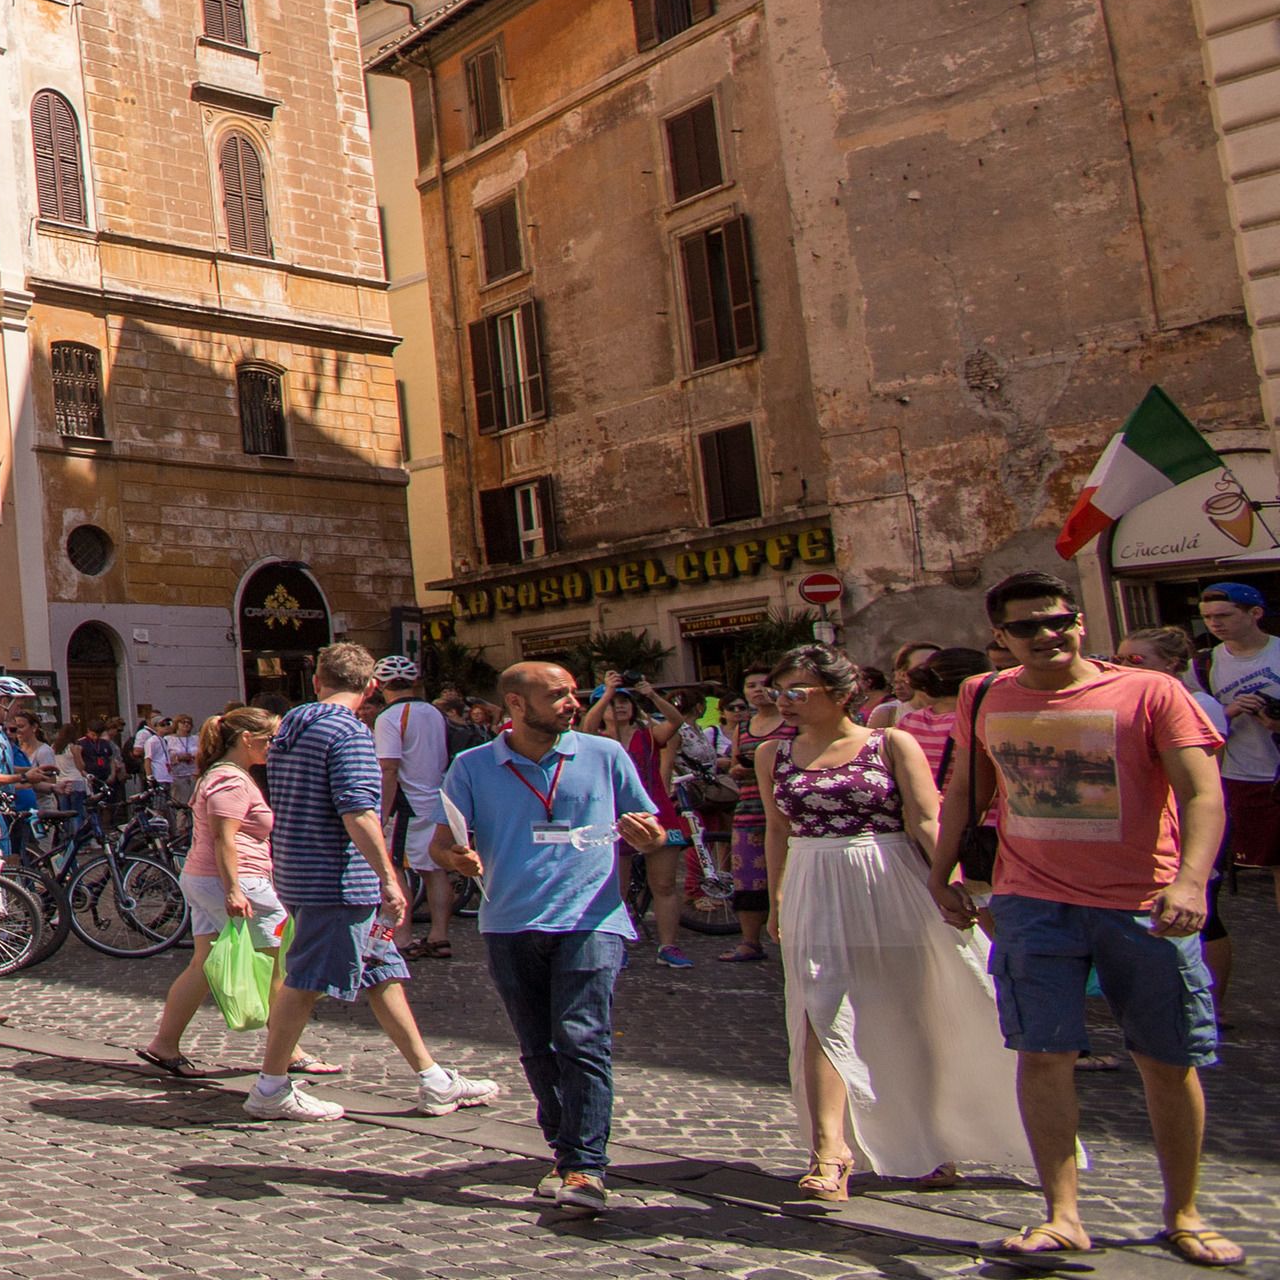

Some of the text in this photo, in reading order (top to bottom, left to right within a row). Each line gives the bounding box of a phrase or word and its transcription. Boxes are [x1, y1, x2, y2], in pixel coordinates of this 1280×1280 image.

[451, 589, 490, 619] LA
[495, 572, 585, 610] CASA
[593, 559, 667, 596] DEL
